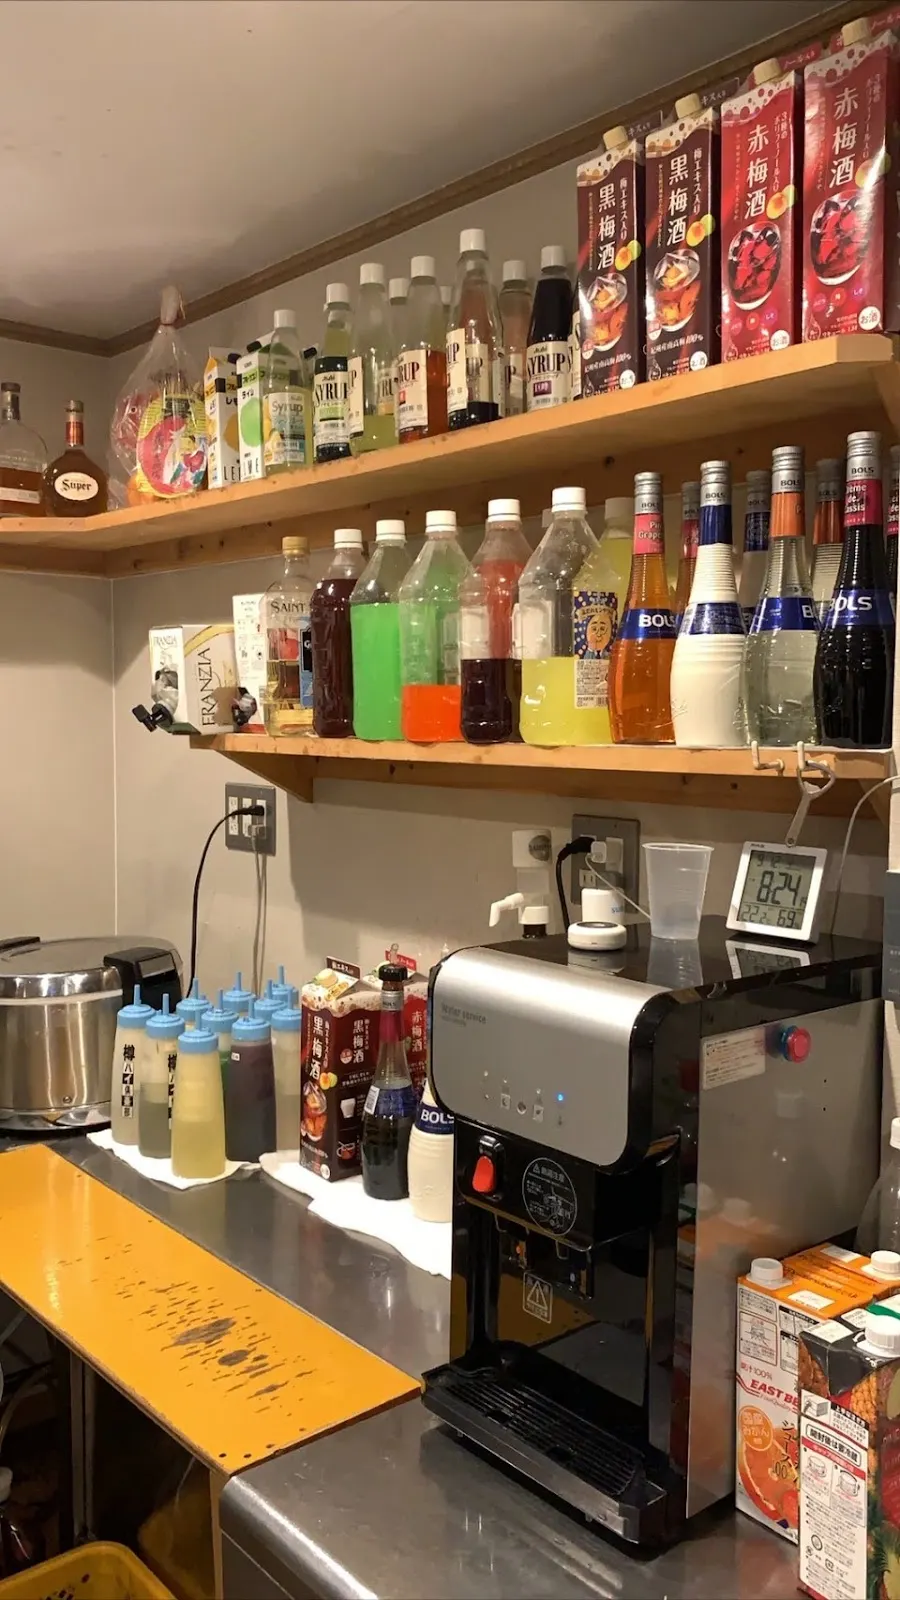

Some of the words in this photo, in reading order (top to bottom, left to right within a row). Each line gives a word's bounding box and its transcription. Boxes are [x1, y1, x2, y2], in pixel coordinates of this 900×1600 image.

[780, 110, 788, 140] 3種の
[829, 86, 860, 189] 赤梅酒
[772, 115, 782, 192] ポリフェノール入り
[692, 147, 703, 216] 梅エキス入り
[744, 123, 770, 221] 赤梅酒
[619, 177, 629, 241] 梅エキス入り
[666, 153, 689, 247] 黒梅酒
[597, 182, 617, 271] 黒梅酒
[860, 310, 879, 325] お酒
[398, 361, 420, 384] RUP
[527, 353, 566, 384] SYRUP
[271, 400, 303, 415] Syrup
[61, 478, 92, 492] Super
[851, 466, 875, 475] BOLS
[705, 491, 726, 500] BOLS
[844, 503, 866, 515] assis
[270, 600, 305, 614] SAINT
[197, 647, 216, 726] FRANZIA
[776, 909, 797, 929] 69
[310, 1015, 324, 1080] 黒梅酒
[352, 1018, 365, 1064] 黒梅酒
[411, 1011, 423, 1053] 赤梅酒
[420, 1108, 455, 1126] BOLS
[749, 1378, 785, 1399] EAST
[809, 1427, 859, 1463] 開封後は要冷蔵
